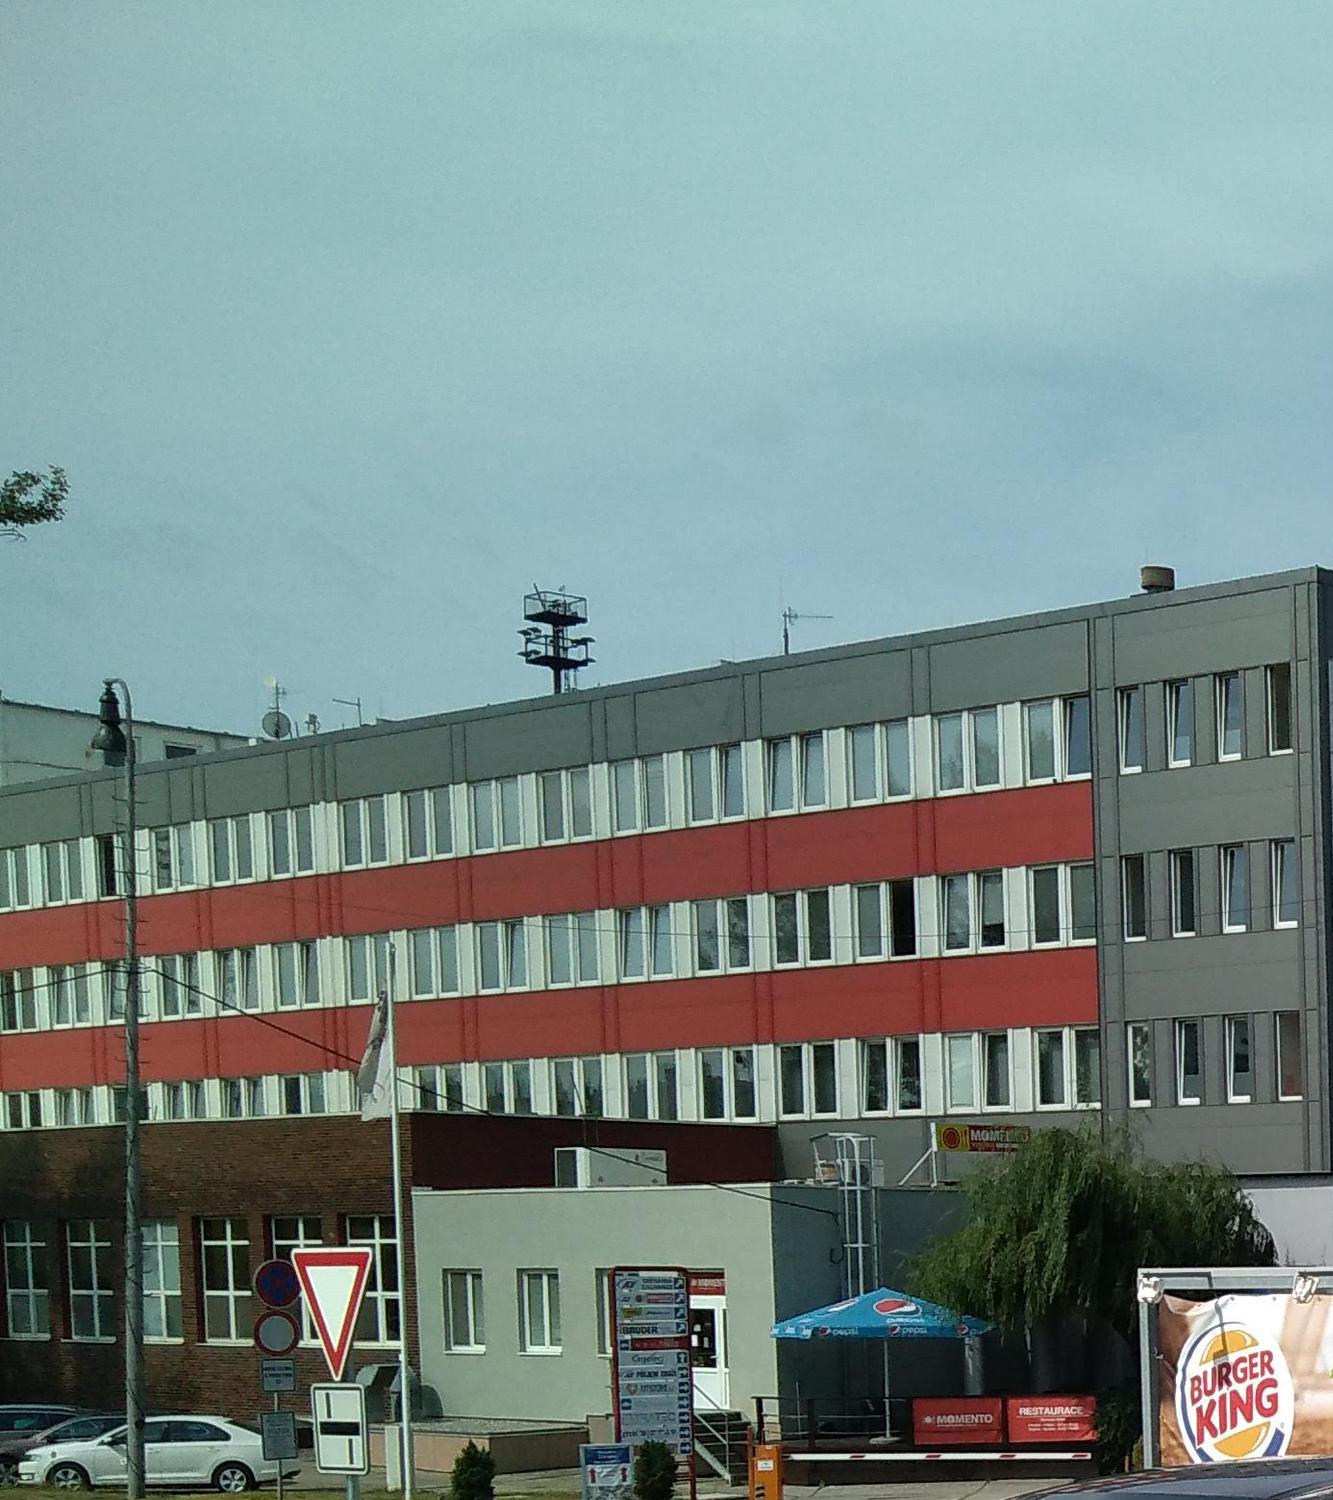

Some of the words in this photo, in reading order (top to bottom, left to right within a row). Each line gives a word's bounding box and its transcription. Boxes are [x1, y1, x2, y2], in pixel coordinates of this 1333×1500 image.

[902, 1326, 928, 1336] pepsi
[1190, 1350, 1275, 1406] BURGER
[1019, 1406, 1084, 1416] RESTAURACE
[1196, 1378, 1279, 1446] KING
[937, 1414, 993, 1424] MOMENTO
